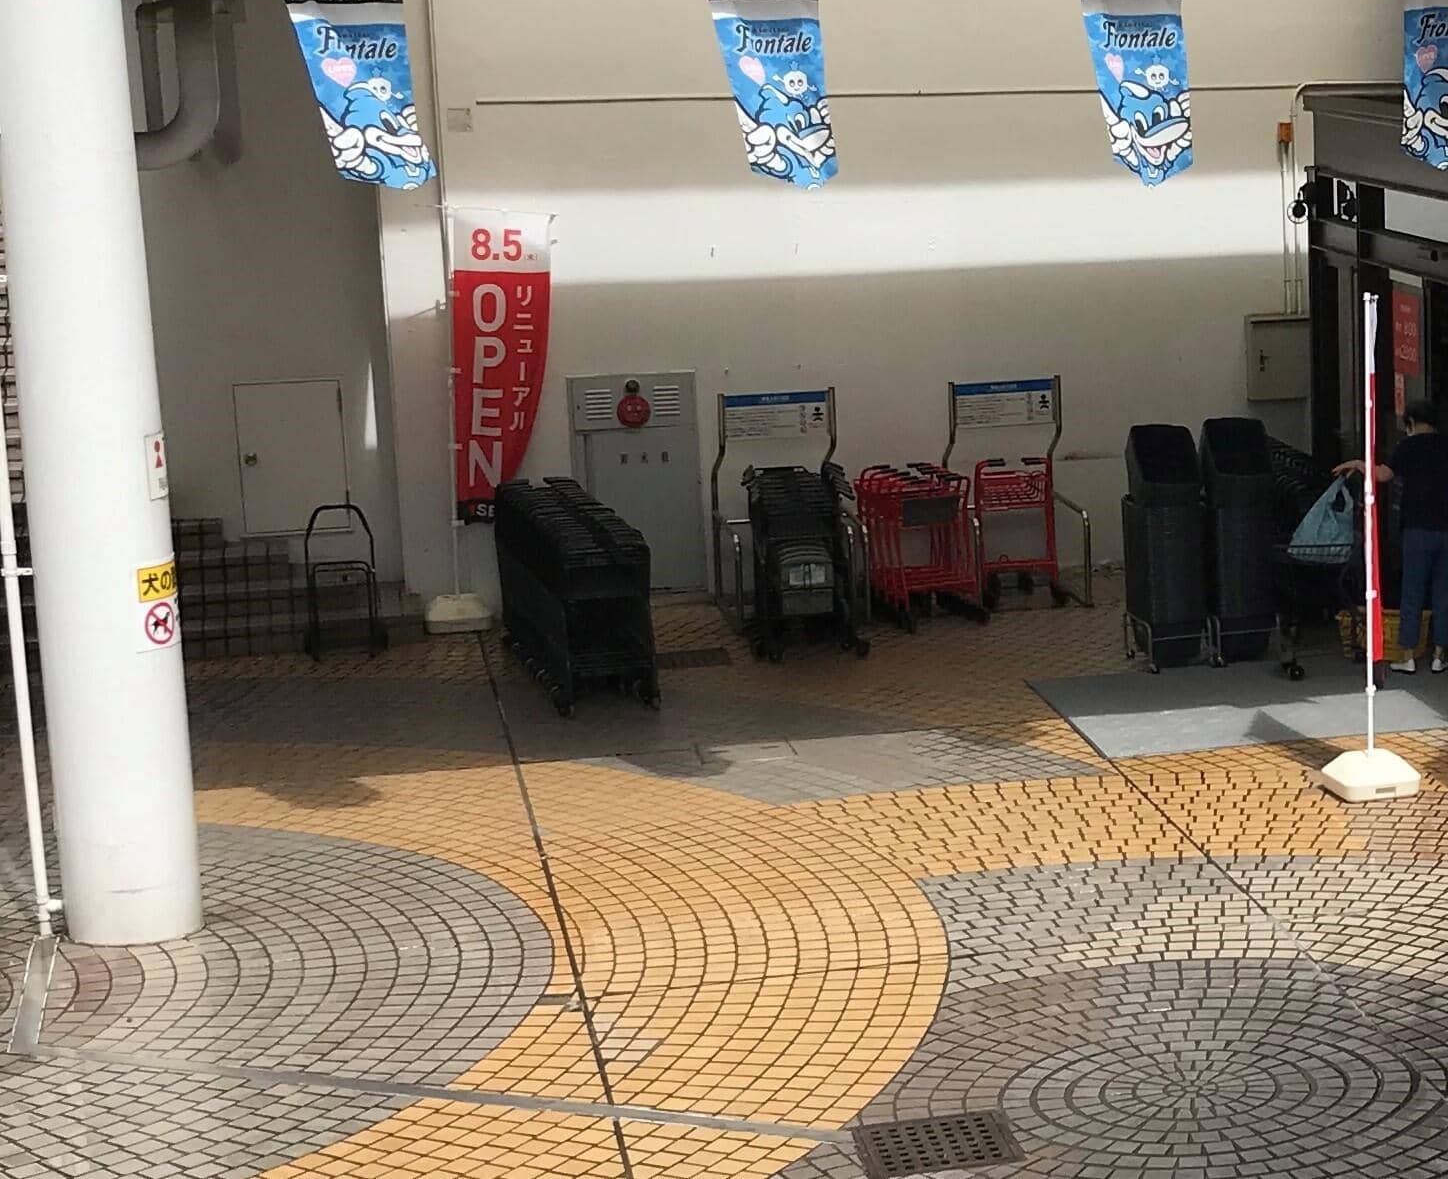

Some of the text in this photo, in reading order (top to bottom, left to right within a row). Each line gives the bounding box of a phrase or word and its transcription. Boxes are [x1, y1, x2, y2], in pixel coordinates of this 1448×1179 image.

[315, 25, 398, 61] Frntale
[1102, 20, 1177, 49] Frontale
[471, 229, 522, 261] 8.5
[509, 284, 535, 431] リニューアル
[468, 283, 507, 487] OPEN
